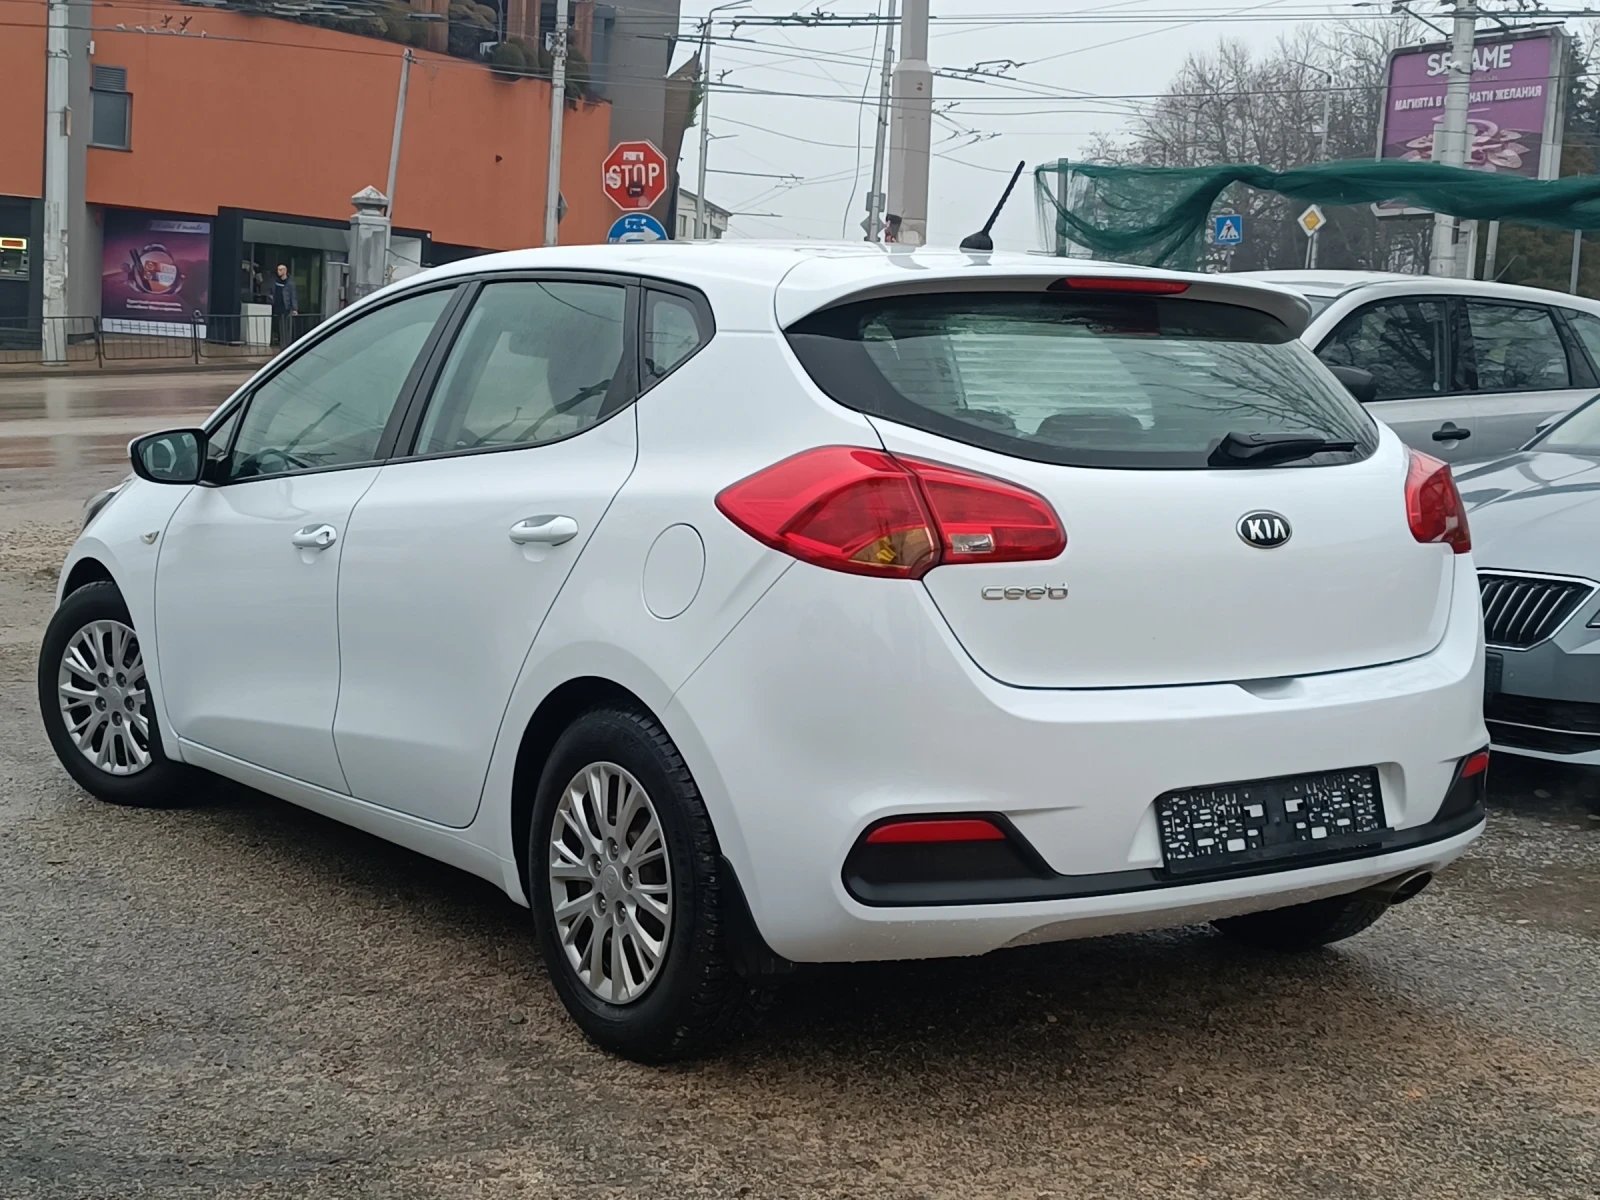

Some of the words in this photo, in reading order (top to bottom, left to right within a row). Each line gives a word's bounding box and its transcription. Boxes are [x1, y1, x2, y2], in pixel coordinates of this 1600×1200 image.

[1426, 44, 1514, 77] SEAME
[1394, 96, 1435, 111] МАГИЯТА
[1435, 96, 1443, 107] В
[1494, 85, 1542, 101] ЖЕЛАНИЯ
[609, 163, 660, 190] STOP
[1246, 518, 1287, 540] KIA
